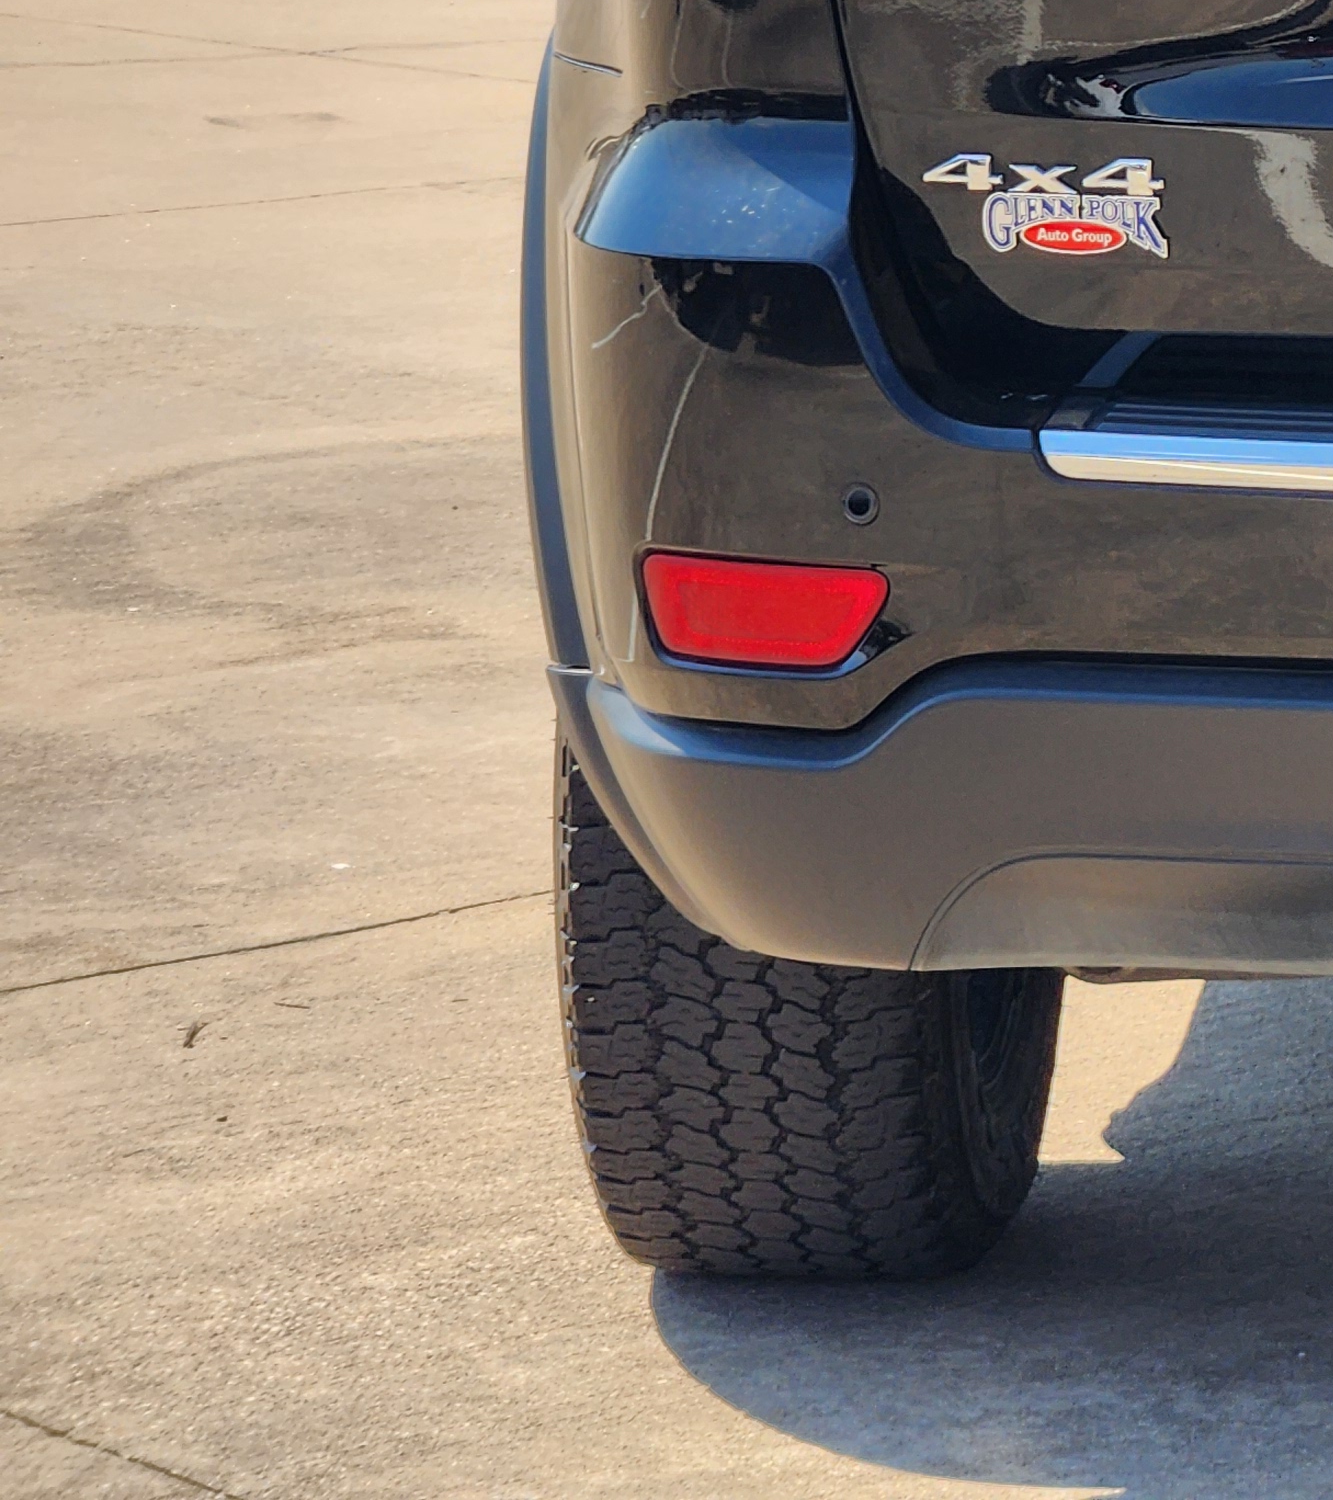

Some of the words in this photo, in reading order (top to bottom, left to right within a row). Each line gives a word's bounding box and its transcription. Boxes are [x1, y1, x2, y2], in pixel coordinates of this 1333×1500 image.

[921, 152, 1166, 196] 4x4
[984, 194, 1079, 250] GLENN
[1086, 197, 1167, 255] POLK
[1037, 227, 1069, 242] Auto
[1071, 228, 1113, 246] Group
